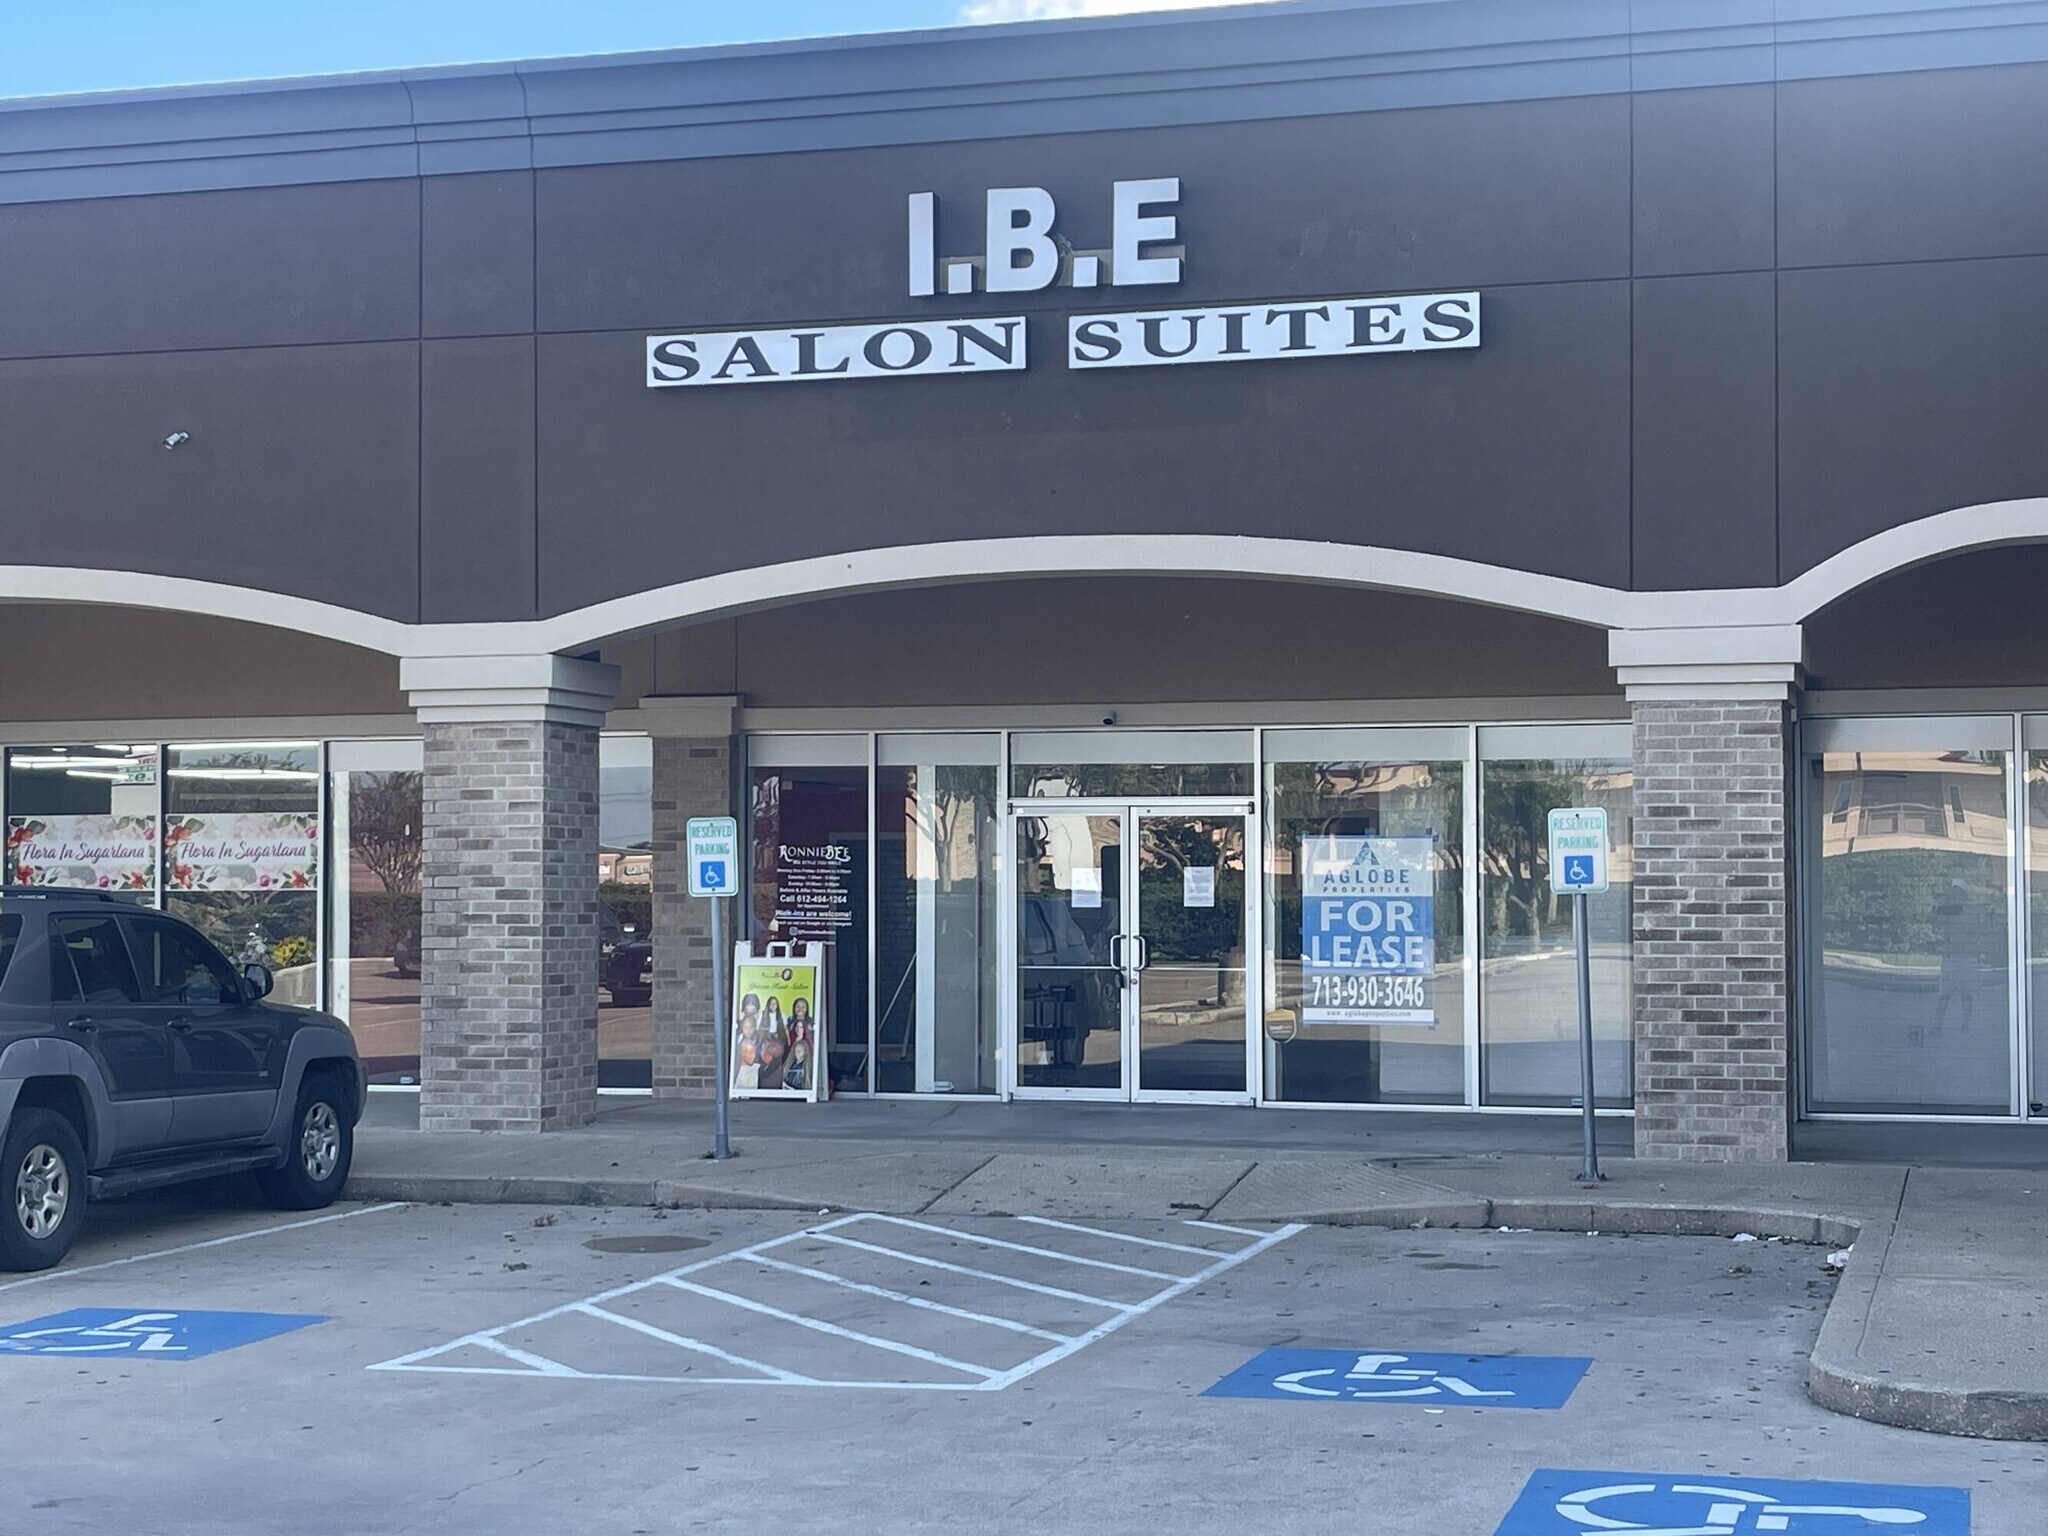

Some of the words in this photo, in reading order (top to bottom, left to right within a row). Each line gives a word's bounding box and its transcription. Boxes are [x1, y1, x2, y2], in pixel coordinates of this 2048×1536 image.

[909, 177, 1180, 297] I.B.E
[652, 322, 1021, 381] SALON
[1074, 300, 1474, 361] SUITES
[691, 825, 732, 838] RESERVED
[1553, 816, 1602, 830] RESERVED
[22, 843, 56, 860] Flora
[59, 842, 74, 860] In
[180, 842, 215, 859] Flora
[219, 841, 233, 859] In
[695, 842, 730, 855] PARKING
[1557, 836, 1599, 849] PARKING
[1324, 869, 1409, 884] AGLOBE
[780, 894, 795, 902] Call
[1320, 900, 1414, 932] FOR
[1311, 935, 1424, 968] LEASE
[1312, 976, 1425, 1007] 713-930-3646
